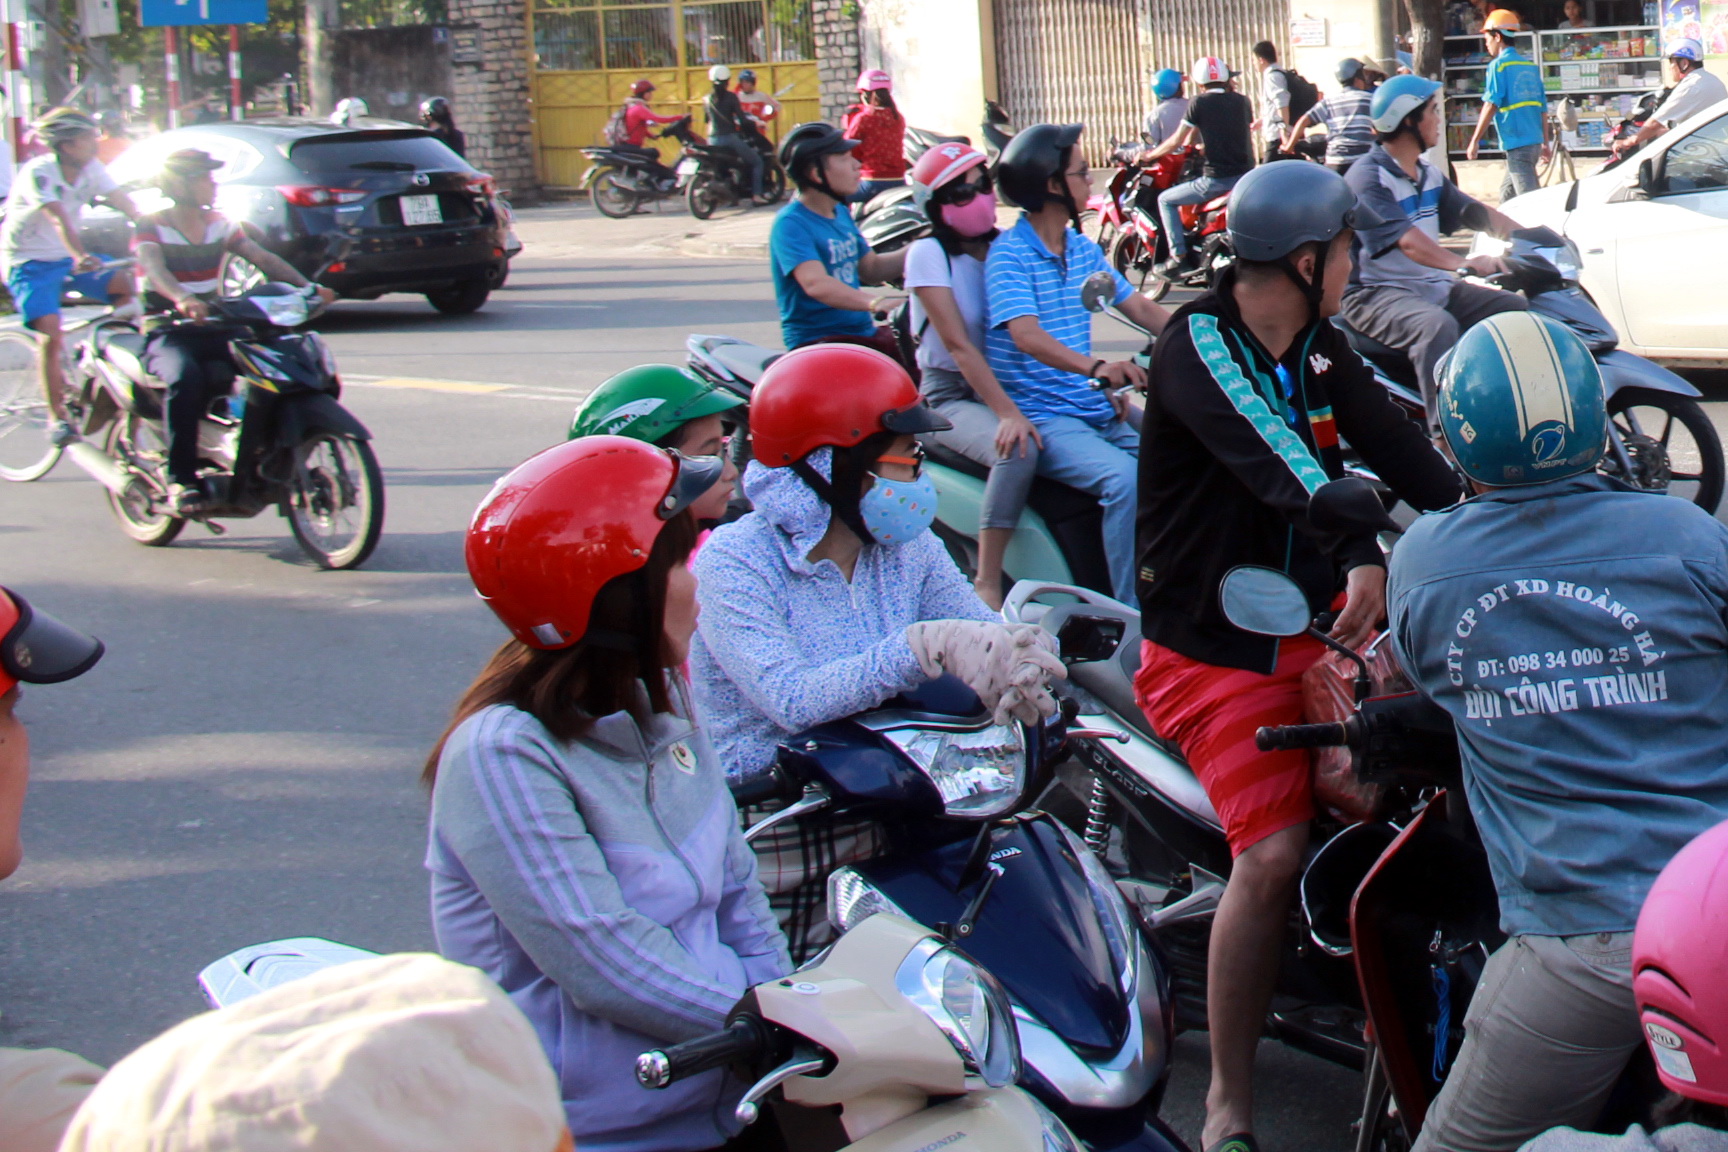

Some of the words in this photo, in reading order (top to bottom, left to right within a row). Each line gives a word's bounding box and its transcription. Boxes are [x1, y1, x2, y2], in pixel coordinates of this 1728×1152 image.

[1463, 424, 1475, 439] 3G
[1531, 458, 1567, 470] VNPT
[1447, 641, 1464, 687] CTY
[1456, 607, 1478, 638] CP
[1477, 583, 1510, 613] ĐT
[1514, 578, 1549, 596] XD
[1556, 580, 1640, 631] HOÀNG
[1633, 630, 1667, 666] HÀ
[1478, 658, 1506, 678] ĐT:
[1508, 652, 1541, 674] 098
[1545, 651, 1567, 668] 34
[1571, 648, 1604, 666] 000
[1609, 646, 1631, 663] 25
[1463, 683, 1503, 727] ĐỘI
[1504, 675, 1579, 717] CÔNG
[1583, 665, 1668, 708] TRÌNH
[990, 846, 1022, 861] NDA
[1648, 1024, 1677, 1047] STYLE
